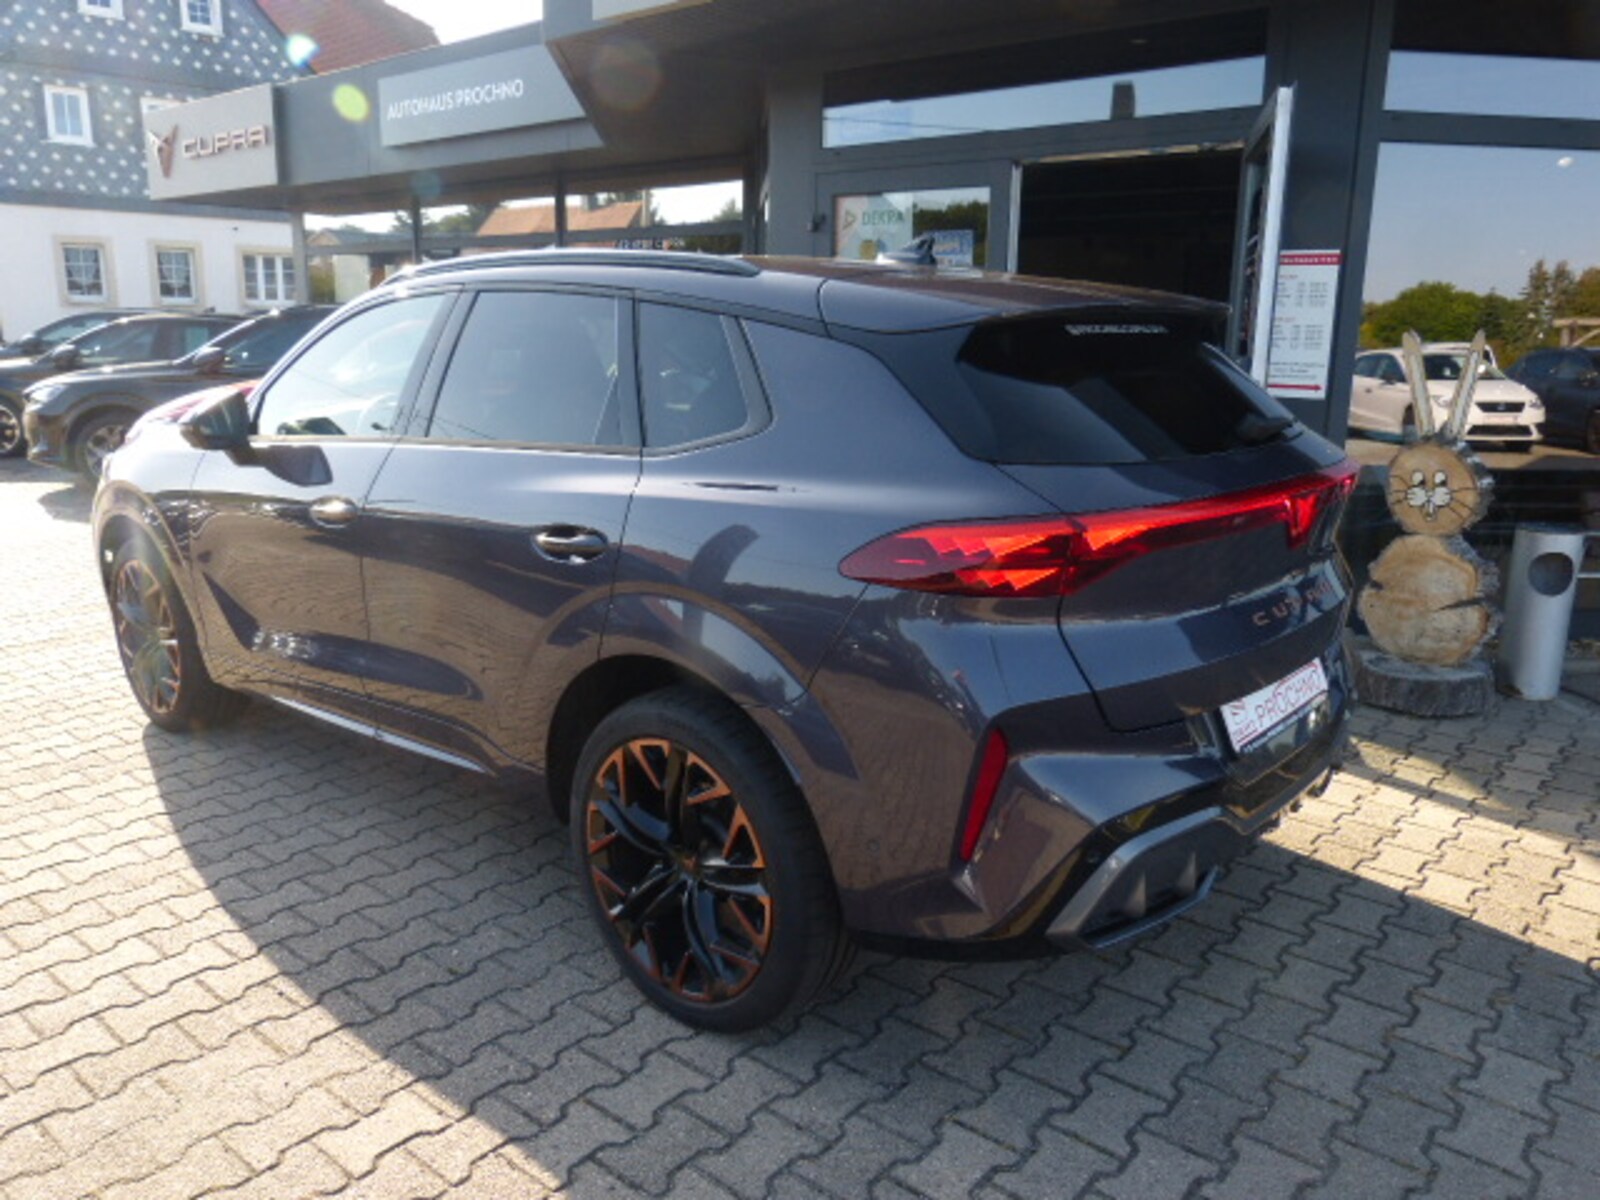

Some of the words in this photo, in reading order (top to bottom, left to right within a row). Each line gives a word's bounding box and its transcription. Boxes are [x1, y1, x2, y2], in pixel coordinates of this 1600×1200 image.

[386, 91, 454, 121] AUTOHAUS
[455, 78, 524, 108] PROCHNO
[182, 125, 268, 158] CUPRA
[861, 209, 905, 226] DEKRA
